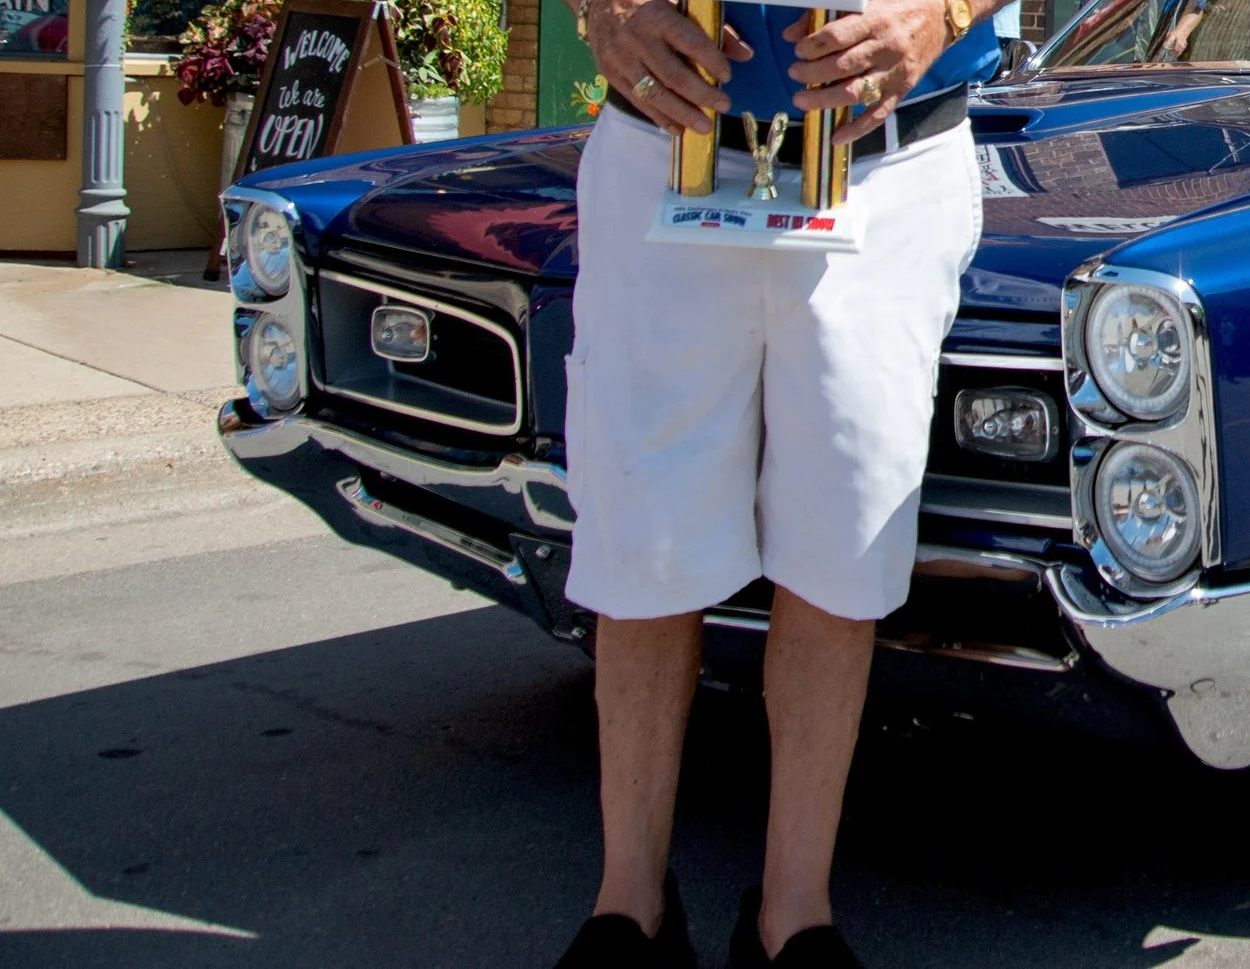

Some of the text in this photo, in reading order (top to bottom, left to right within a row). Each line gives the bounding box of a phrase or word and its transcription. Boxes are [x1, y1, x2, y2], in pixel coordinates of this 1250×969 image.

[284, 29, 351, 74] WELCOME
[303, 88, 325, 108] are
[259, 112, 325, 160] OPEN
[672, 211, 702, 224] CLASSIC
[704, 212, 720, 222] CAR
[766, 214, 791, 229] BEST
[806, 216, 836, 231] SHOW
